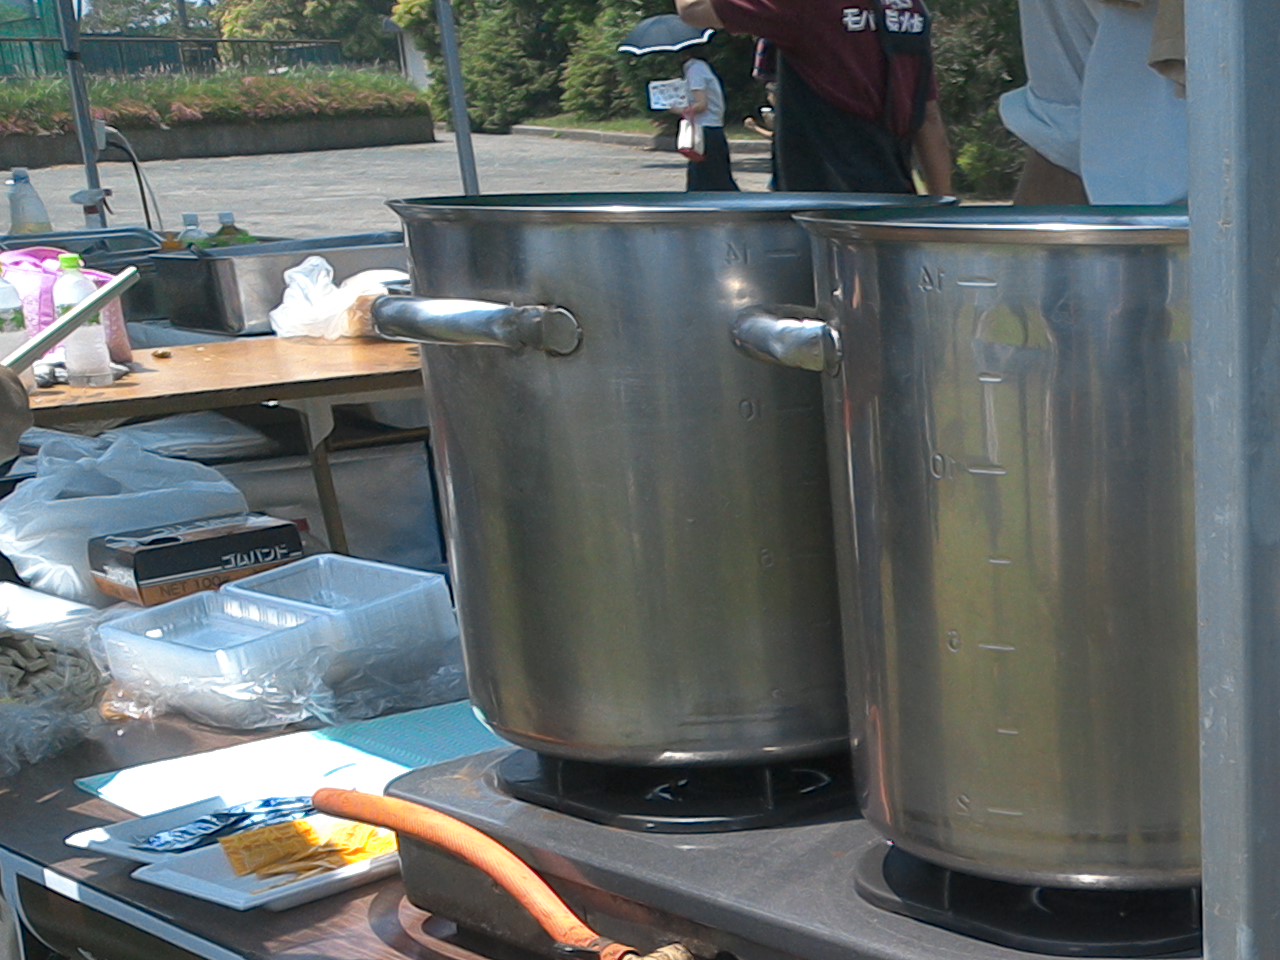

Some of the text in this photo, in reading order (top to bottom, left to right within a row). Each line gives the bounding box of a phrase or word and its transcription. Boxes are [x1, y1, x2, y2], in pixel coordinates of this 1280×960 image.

[220, 543, 289, 569] ゴムバンド
